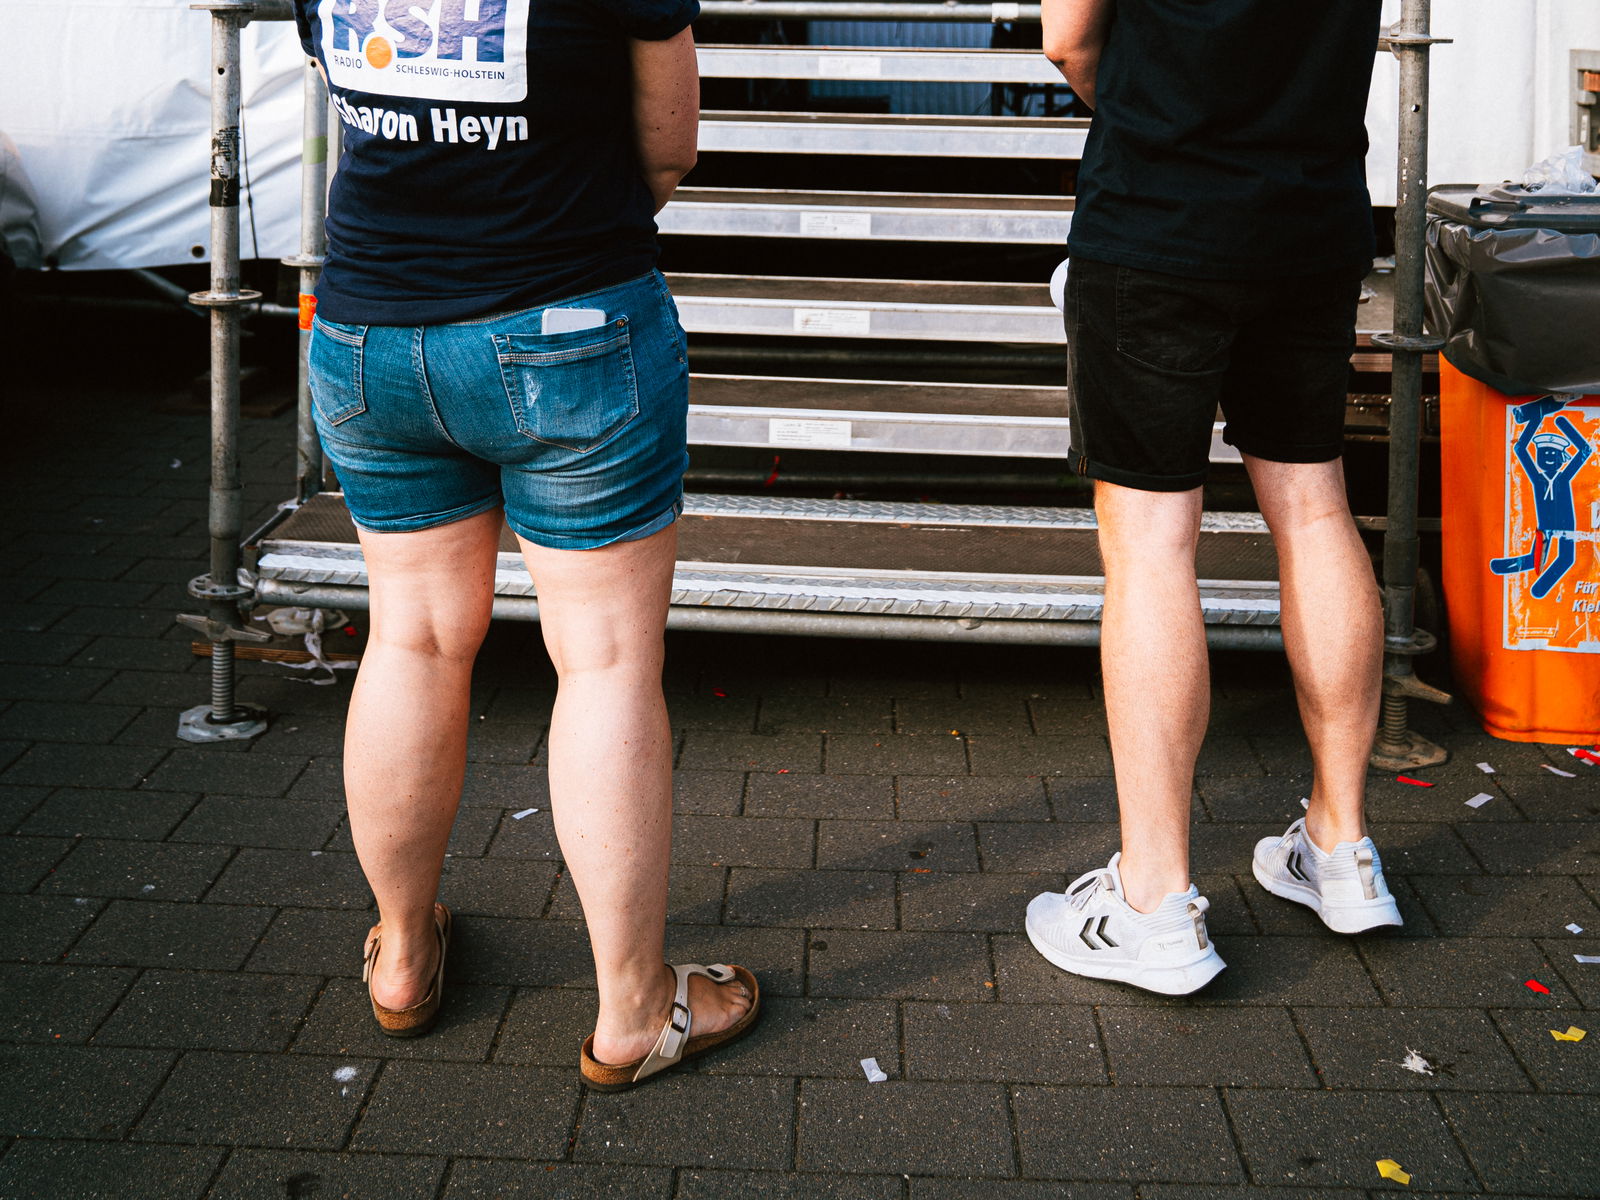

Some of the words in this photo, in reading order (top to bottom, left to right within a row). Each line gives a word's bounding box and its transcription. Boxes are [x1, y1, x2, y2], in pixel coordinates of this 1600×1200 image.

[334, 55, 363, 69] RADIO
[395, 64, 505, 80] SCHLESWIG-HOLSTEIN
[332, 93, 419, 142] Sharon
[430, 108, 529, 150] Heyn
[1574, 580, 1599, 594] Für
